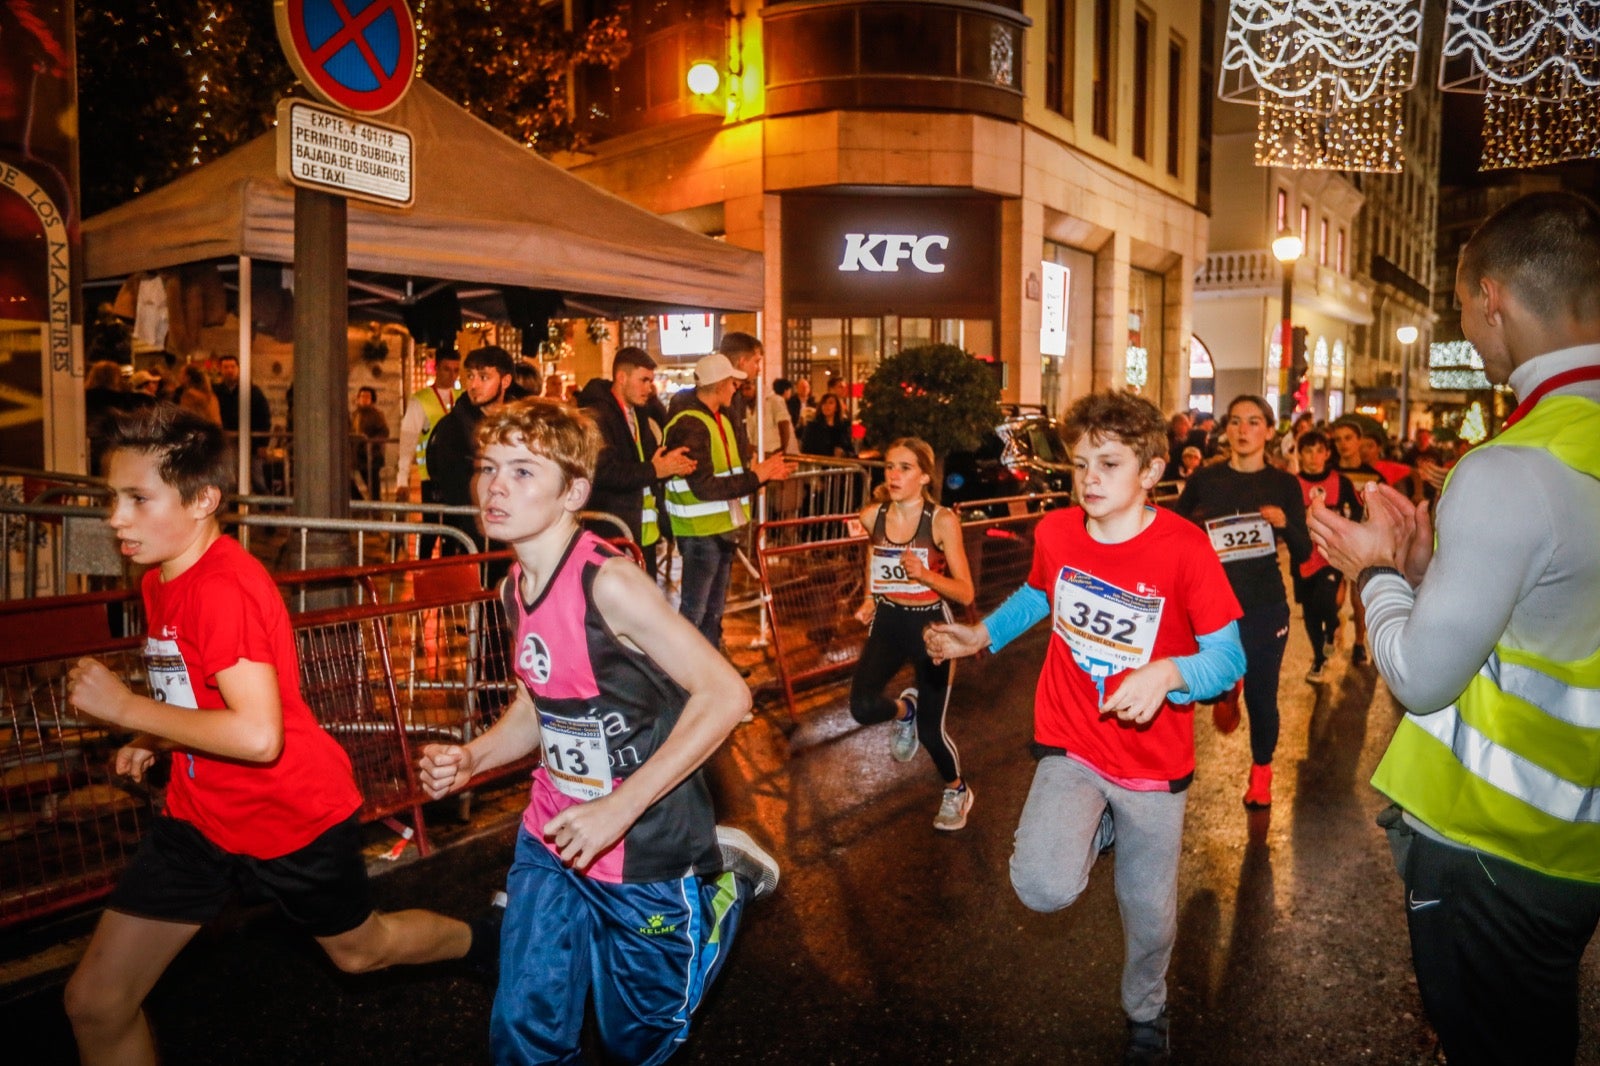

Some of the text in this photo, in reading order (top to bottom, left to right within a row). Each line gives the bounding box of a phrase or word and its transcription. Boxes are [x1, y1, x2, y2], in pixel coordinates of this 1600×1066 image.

[296, 126, 406, 167] PERMITIDO SUBIDA Y
[296, 144, 406, 183] BAJADA DE USUARIOS
[301, 163, 346, 184] DE TAXI
[28, 187, 60, 228] LOS
[838, 233, 950, 273] KFC
[1223, 529, 1263, 547] 322
[1070, 602, 1137, 645] 352
[548, 743, 590, 776] 13
[640, 924, 676, 934] KELME
